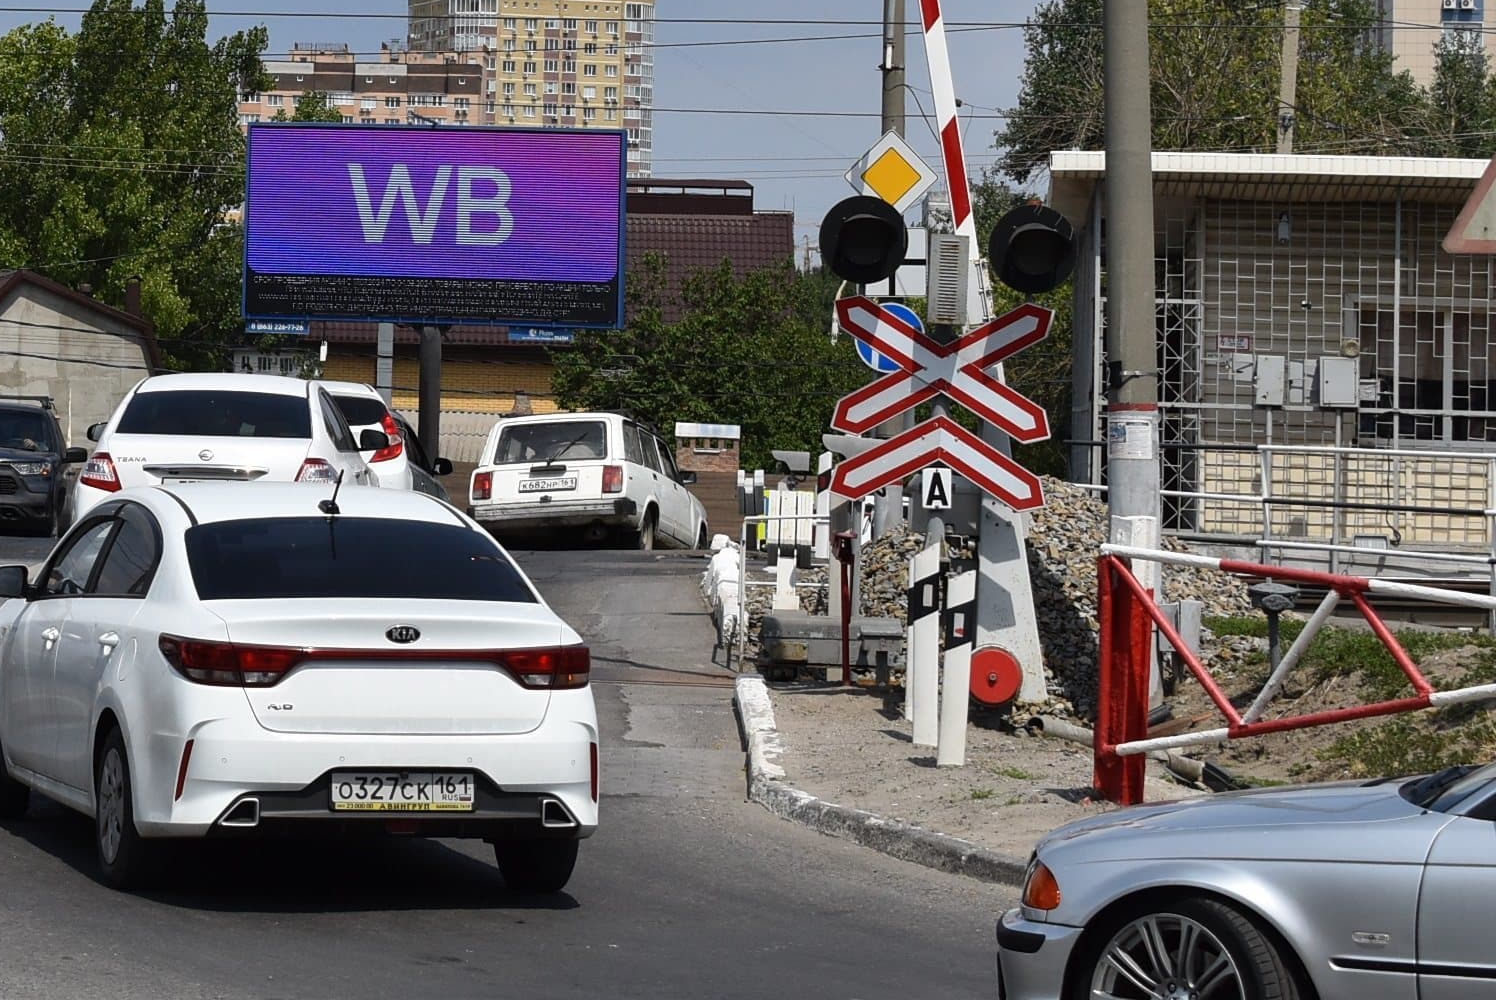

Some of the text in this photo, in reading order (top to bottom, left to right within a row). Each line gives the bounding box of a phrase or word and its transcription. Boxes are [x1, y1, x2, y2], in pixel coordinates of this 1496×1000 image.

[347, 162, 514, 246] WB
[926, 471, 949, 506] А
[392, 628, 416, 640] KIA
[338, 775, 468, 801] О327СК 161
